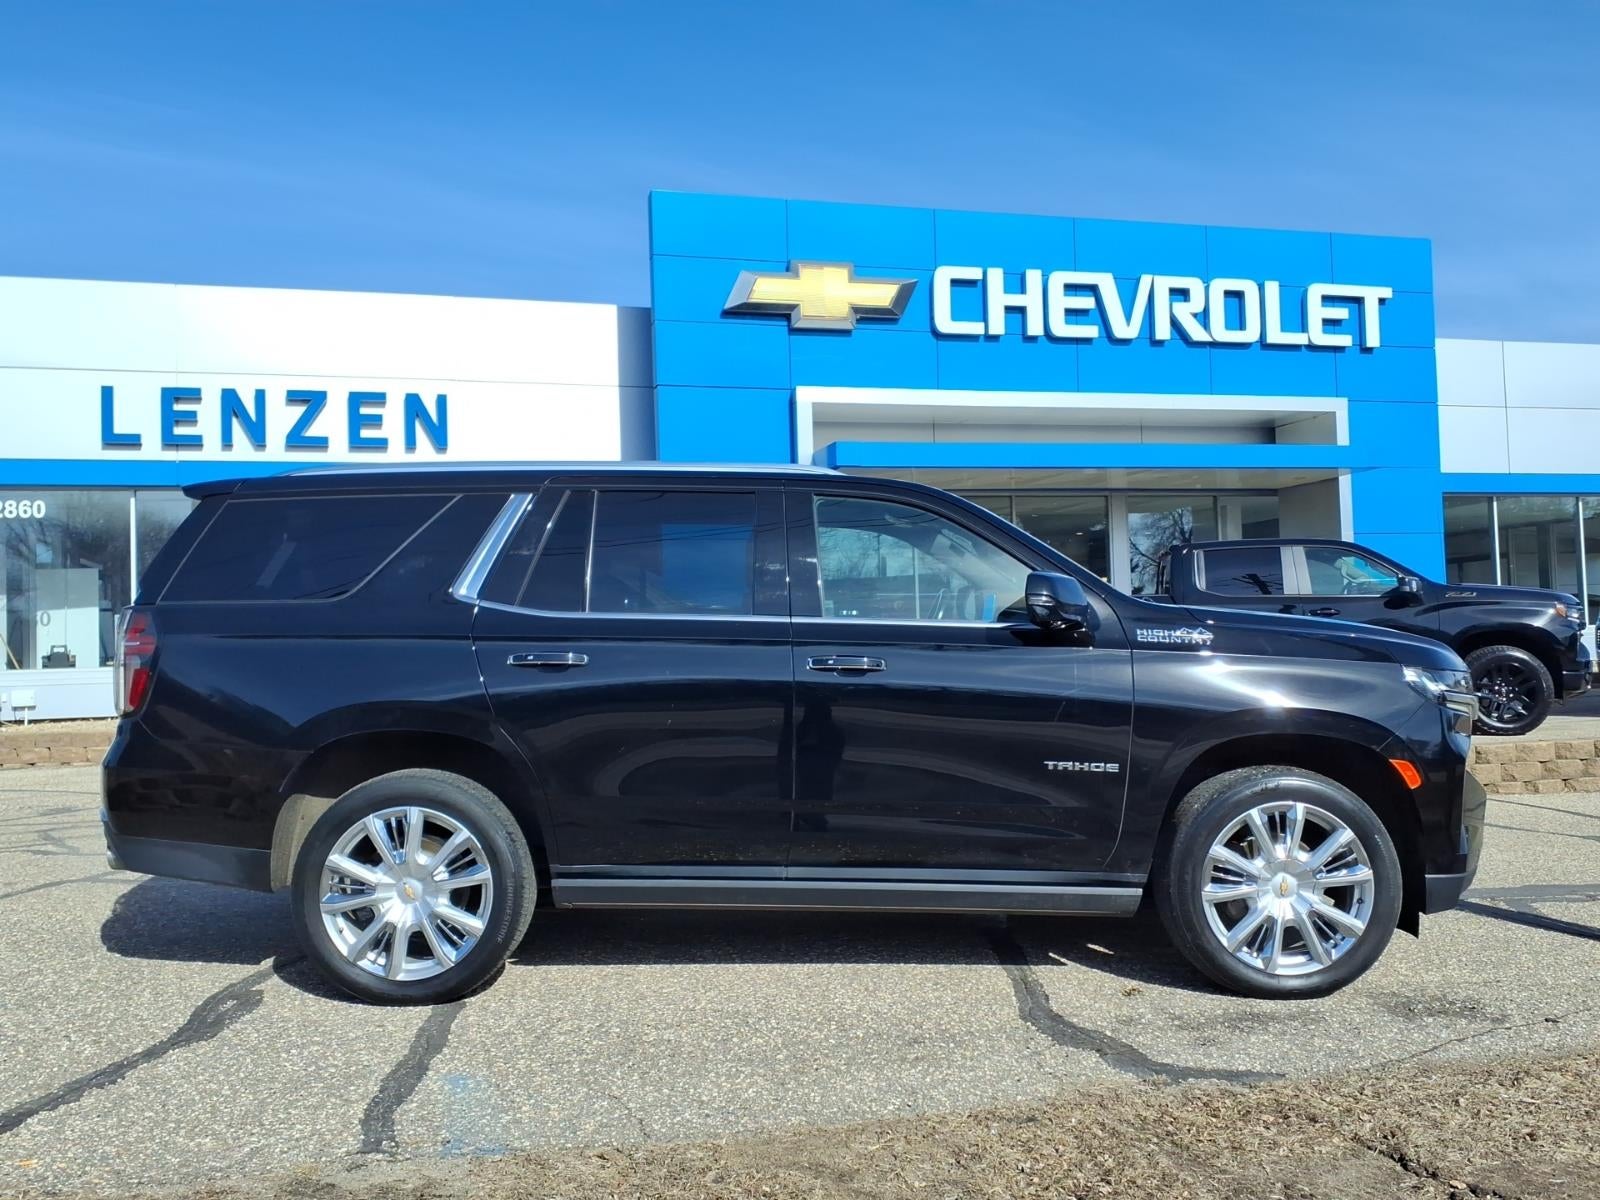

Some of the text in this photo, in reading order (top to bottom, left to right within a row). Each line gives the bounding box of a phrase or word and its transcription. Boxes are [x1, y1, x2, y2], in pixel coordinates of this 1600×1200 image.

[932, 265, 1393, 350] CHEVROLET
[101, 385, 448, 453] LENZEN
[0, 500, 46, 519] 860
[1136, 628, 1175, 636] HIGH
[1043, 761, 1120, 773] TAHOE
